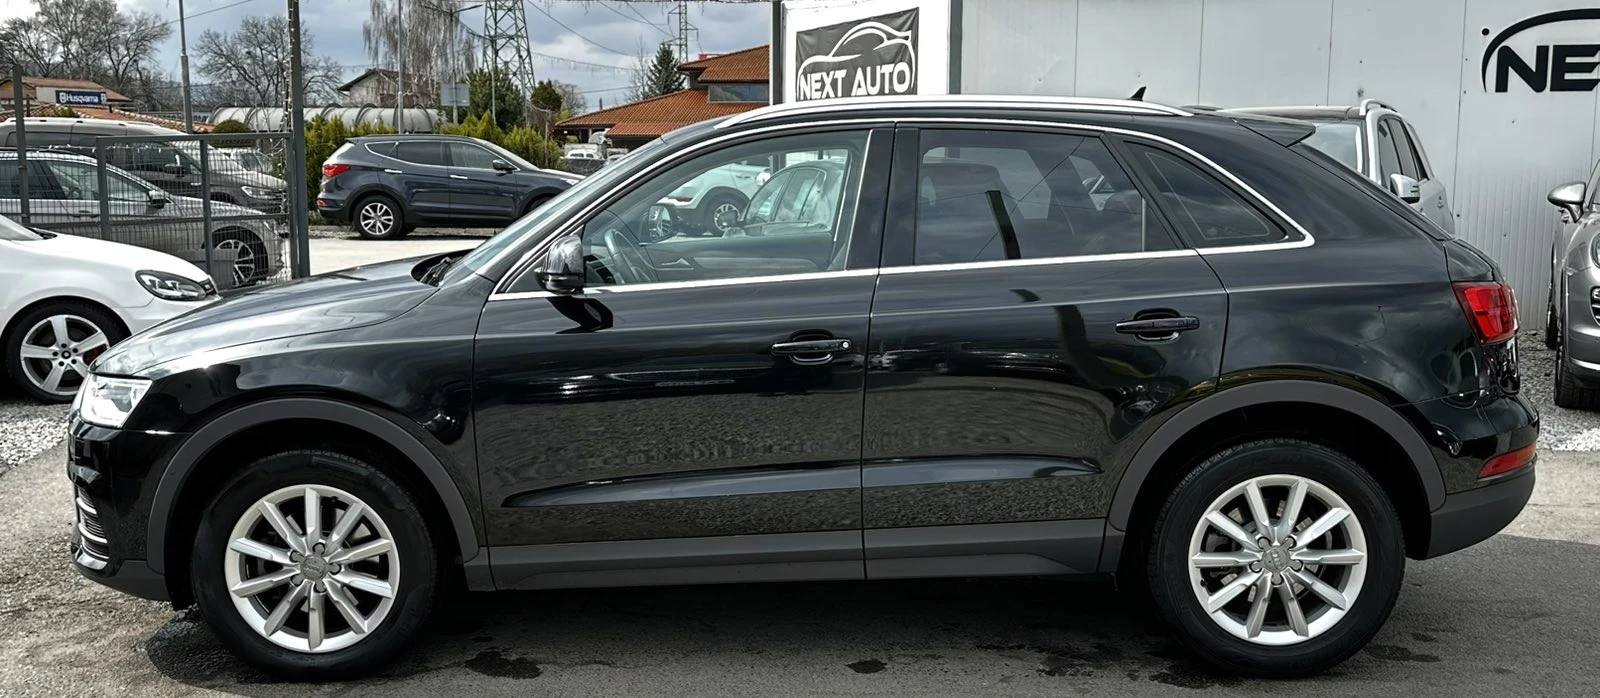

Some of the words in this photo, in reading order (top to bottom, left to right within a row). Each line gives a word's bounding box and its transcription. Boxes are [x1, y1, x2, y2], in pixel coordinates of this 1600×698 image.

[800, 69, 847, 101] NEXT
[851, 62, 910, 97] AUTO
[1495, 44, 1600, 93] NE
[66, 93, 99, 103] Husqvarna
